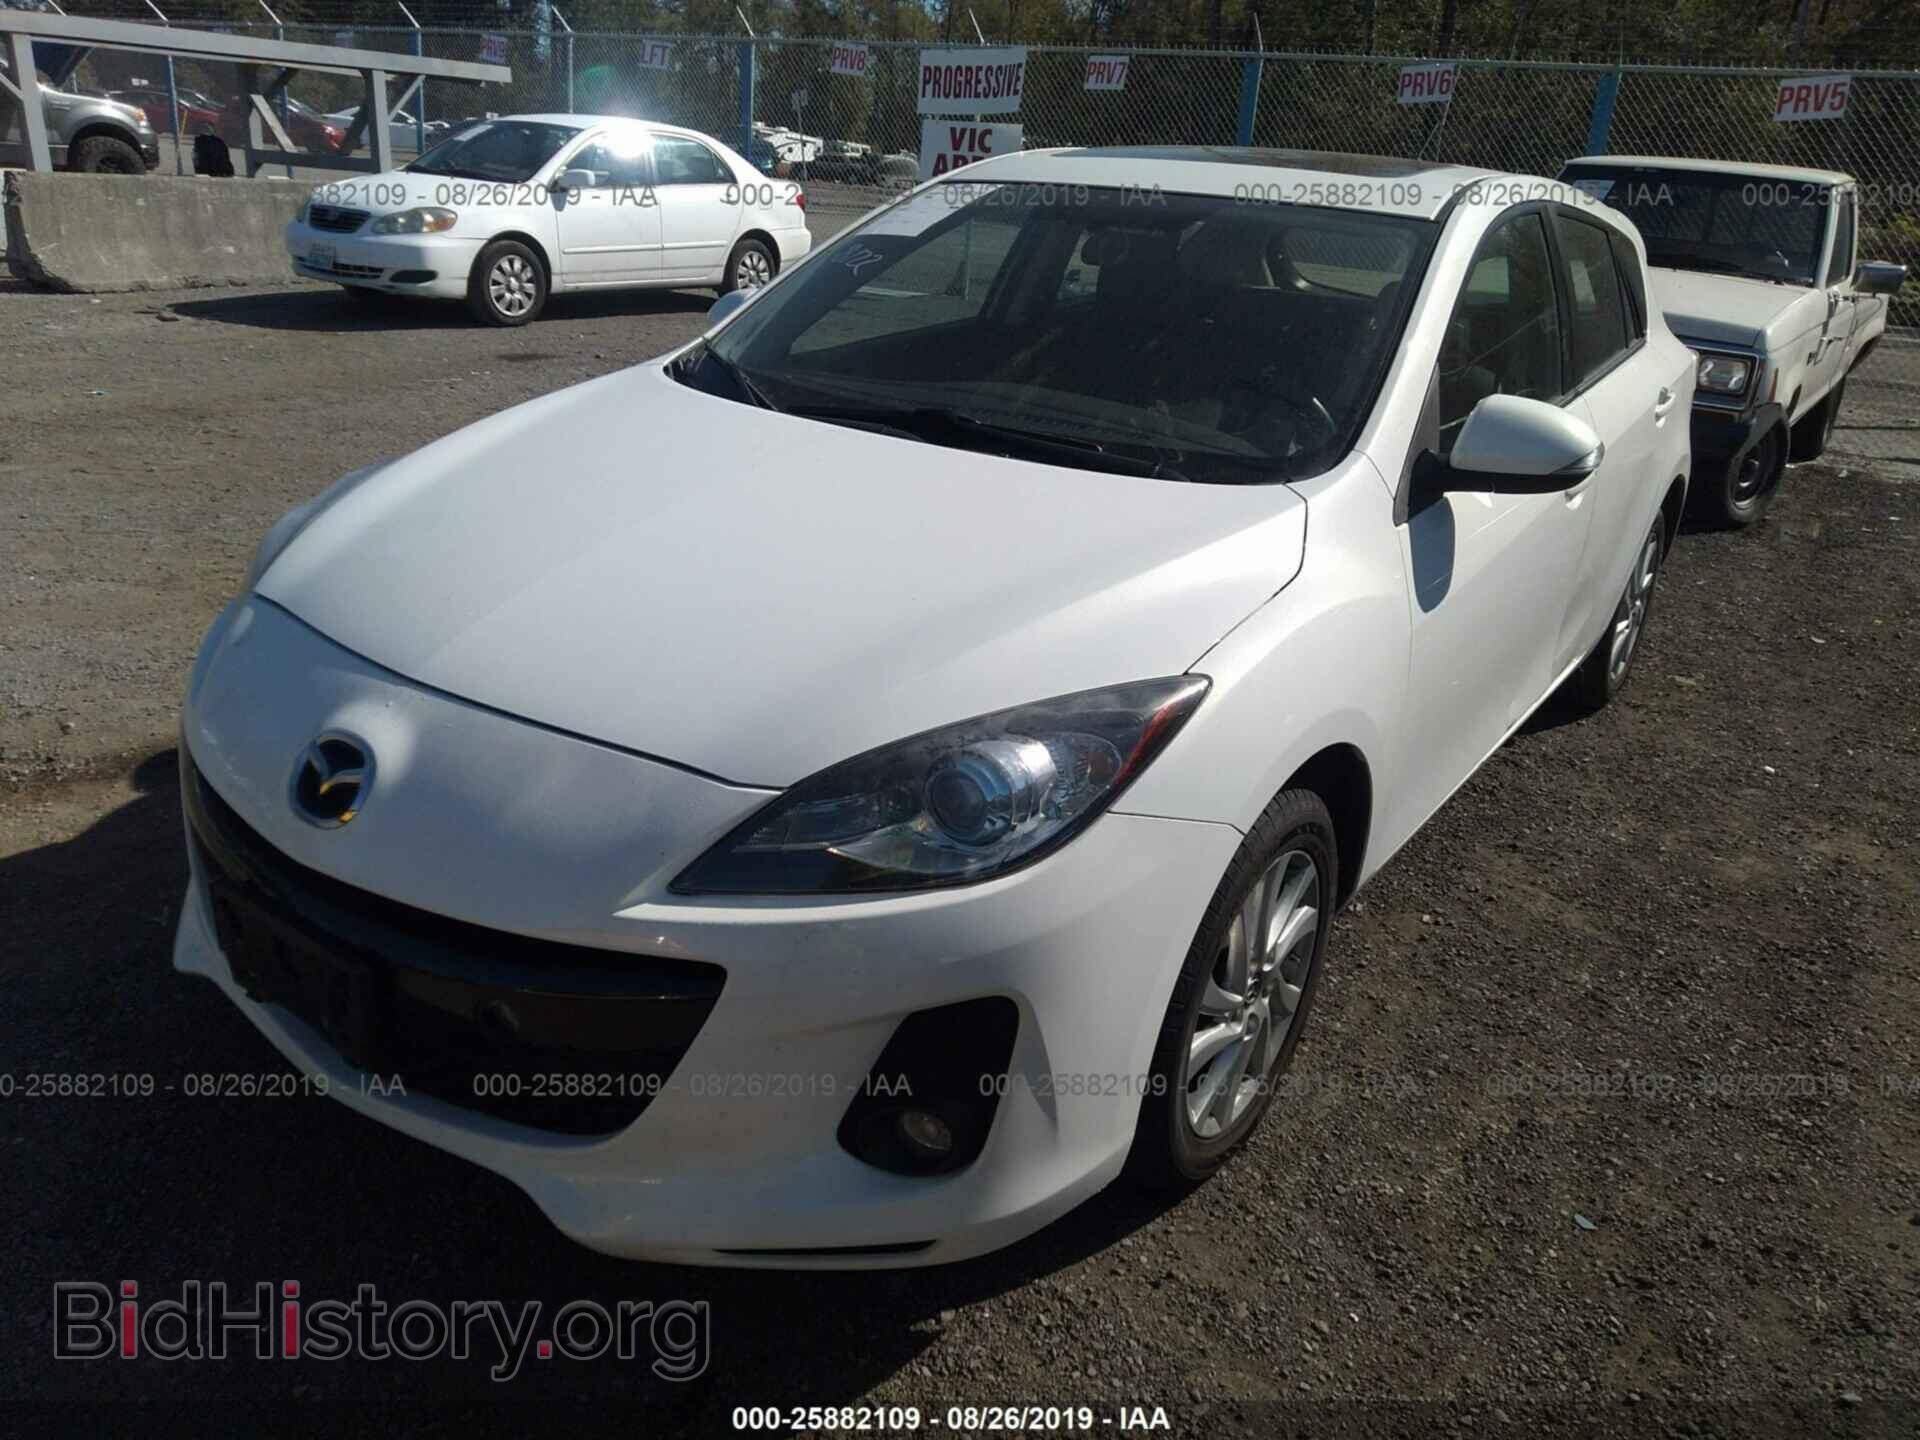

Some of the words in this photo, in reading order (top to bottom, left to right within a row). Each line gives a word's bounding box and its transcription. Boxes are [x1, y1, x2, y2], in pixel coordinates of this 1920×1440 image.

[832, 48, 867, 72] PRV8
[1086, 61, 1127, 84] PRV7
[922, 62, 1023, 99] PROGRESSIVE
[1400, 69, 1452, 97] PRV6
[1776, 82, 1849, 114] PRV5
[950, 127, 993, 153] VIC
